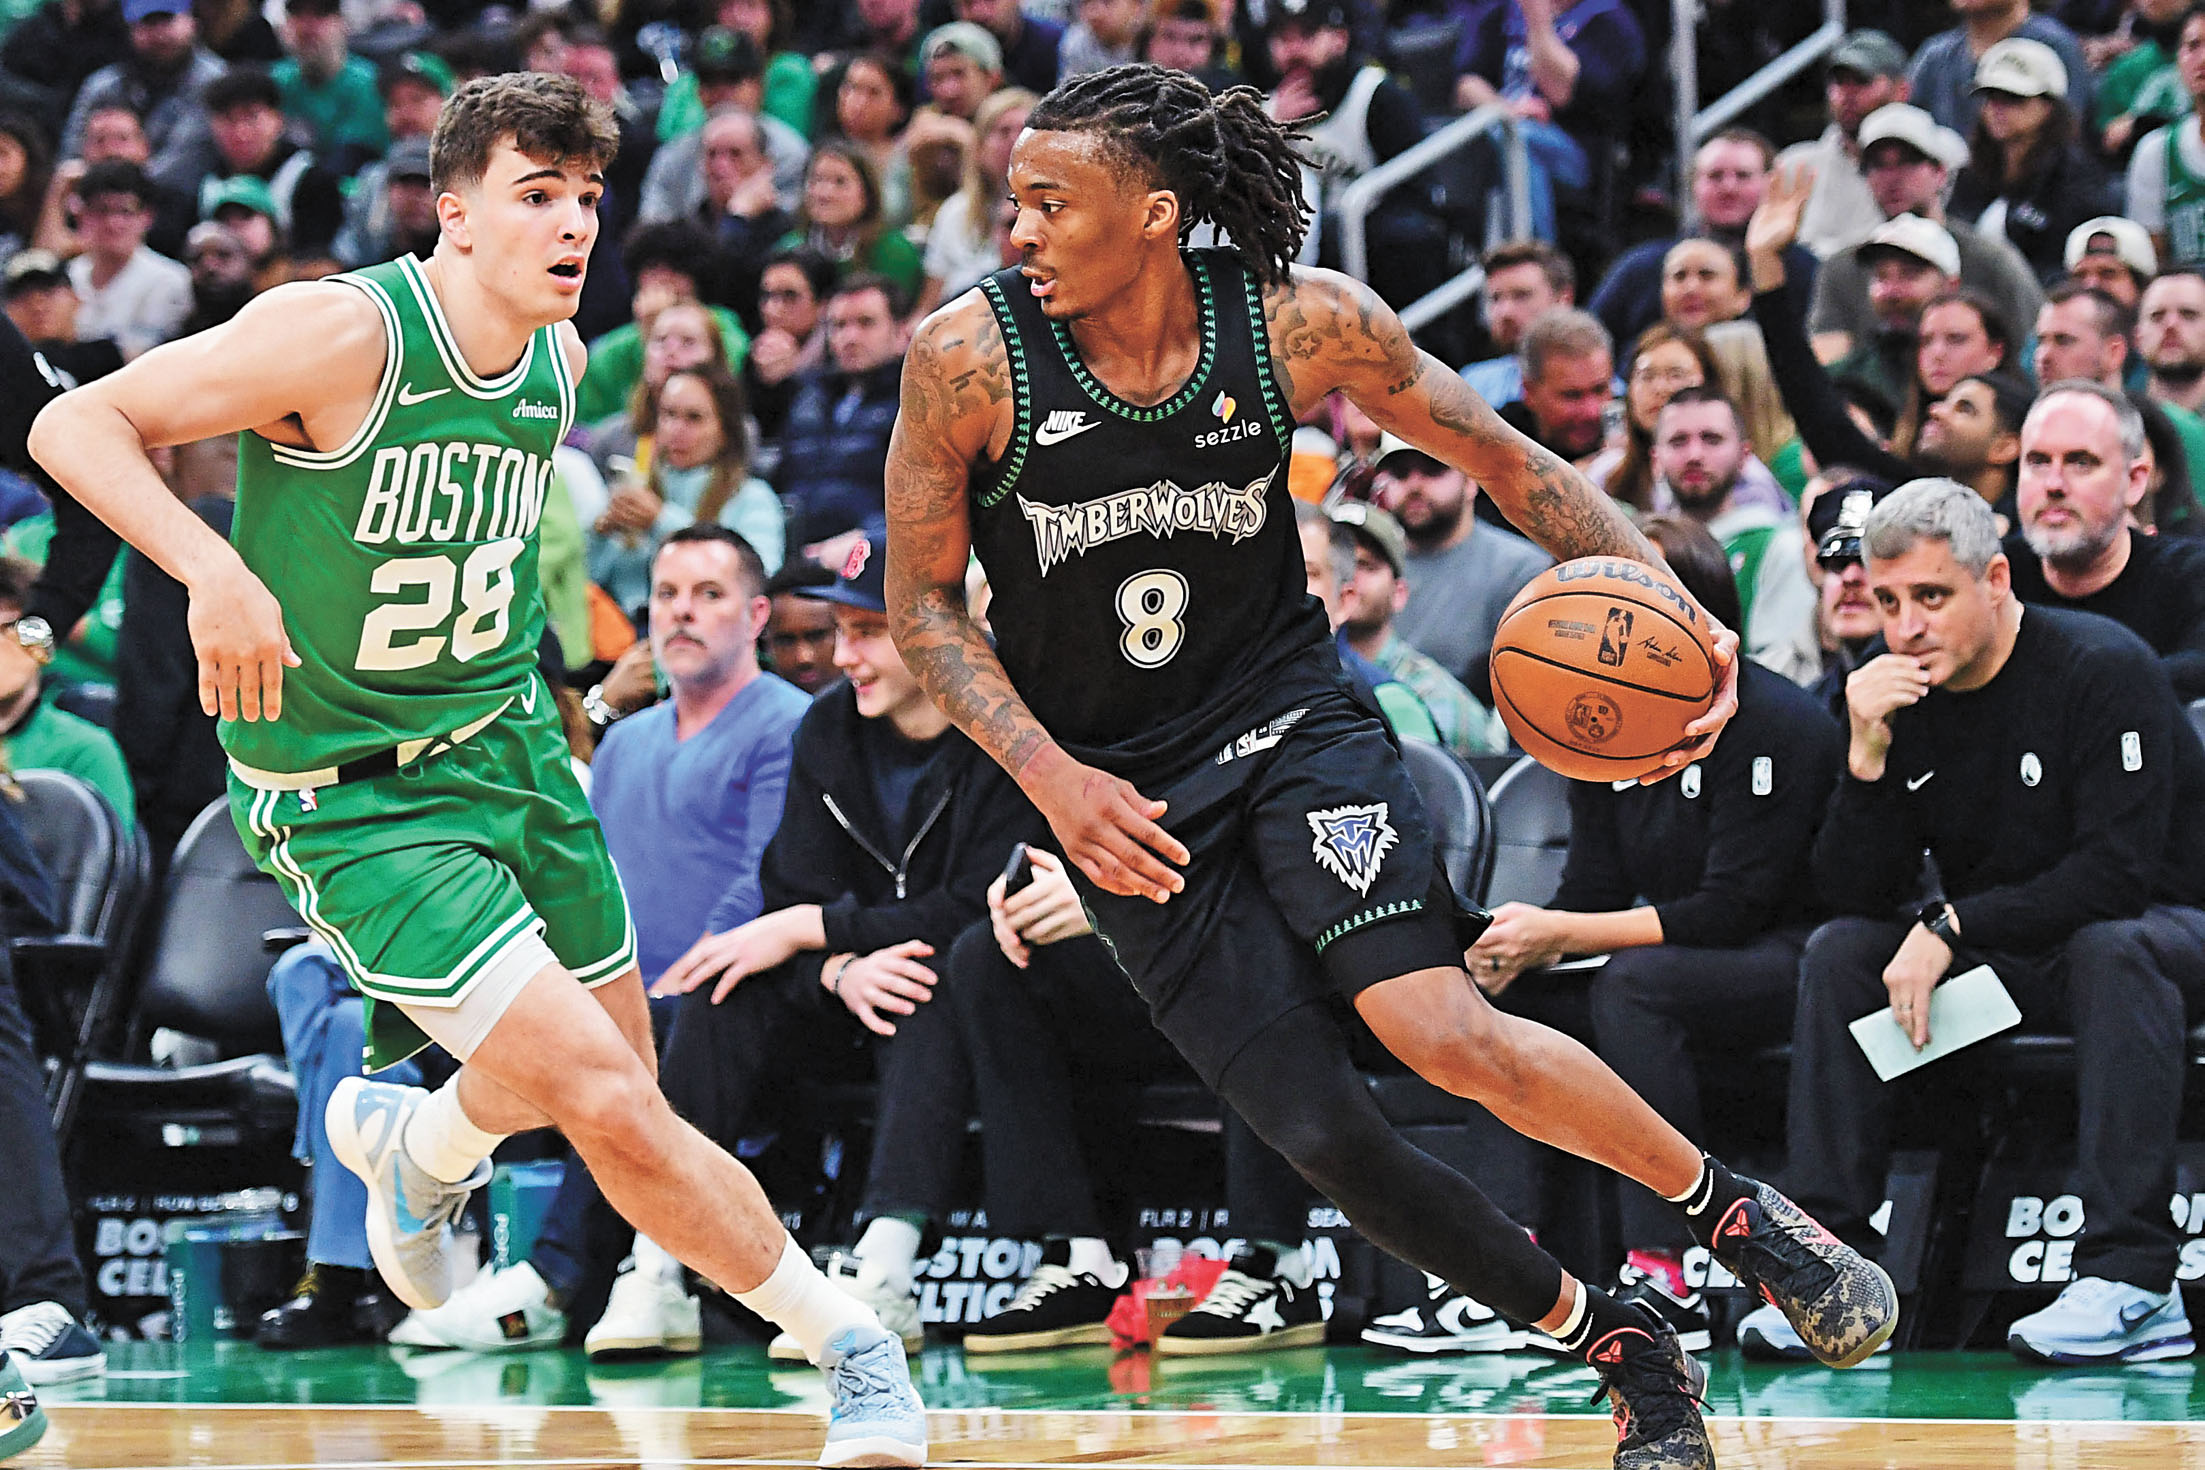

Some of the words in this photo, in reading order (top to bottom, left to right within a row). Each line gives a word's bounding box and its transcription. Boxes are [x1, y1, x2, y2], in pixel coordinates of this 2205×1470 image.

[512, 398, 558, 419] Amica
[1045, 410, 1086, 431] NIKE
[1194, 419, 1262, 449] sezzle
[353, 442, 553, 544] BOSTON
[354, 536, 525, 671] 28
[1115, 568, 1190, 669] 8
[1555, 561, 1697, 626] Wilson
